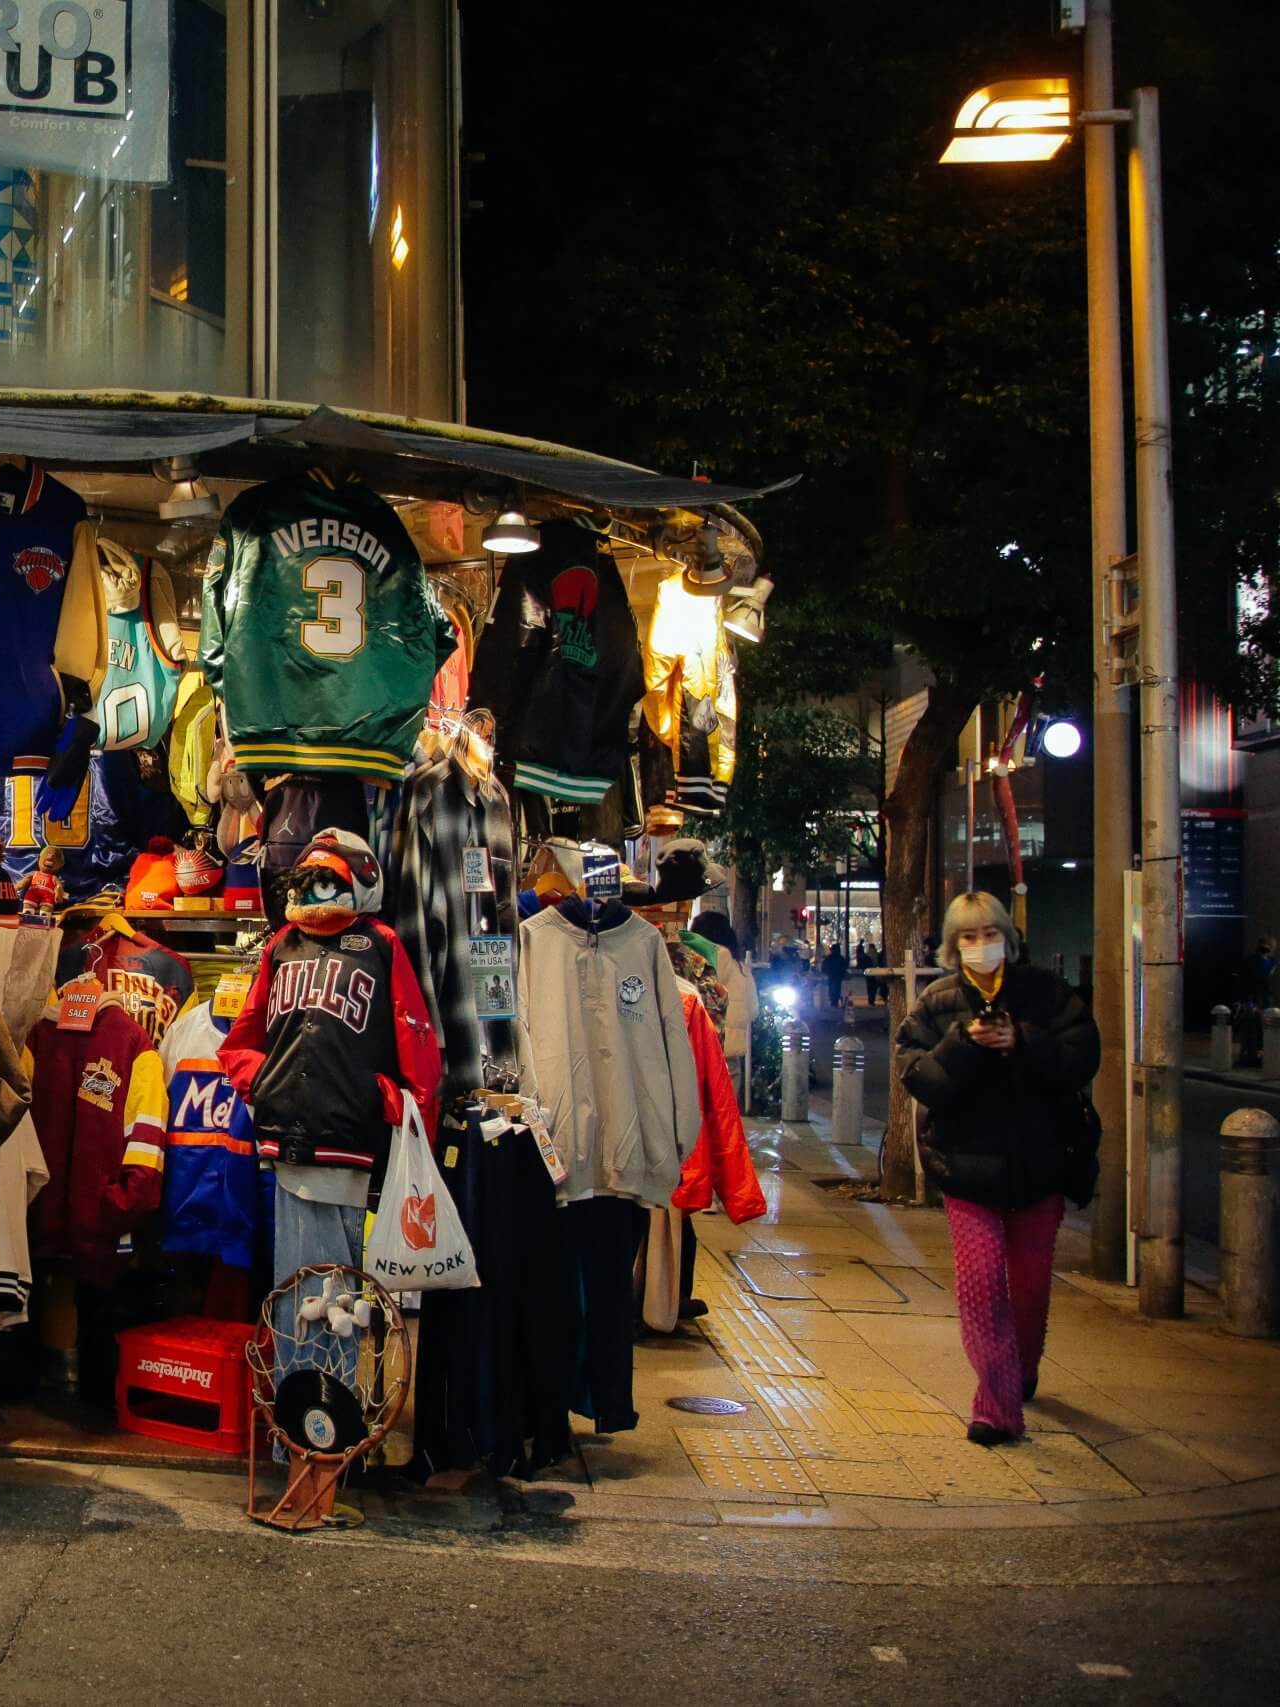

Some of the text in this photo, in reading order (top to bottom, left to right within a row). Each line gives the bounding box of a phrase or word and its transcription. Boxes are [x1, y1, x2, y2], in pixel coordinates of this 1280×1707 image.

[10, 116, 71, 132] Comfort
[271, 518, 391, 574] IVERSON
[299, 556, 365, 657] 3
[589, 876, 617, 885] STOCK
[66, 993, 97, 1004] WINTER
[266, 958, 376, 1034] BULLS
[68, 1008, 88, 1019] SALE
[375, 1251, 465, 1277] NEW YORK
[137, 1359, 214, 1389] Budweiser
